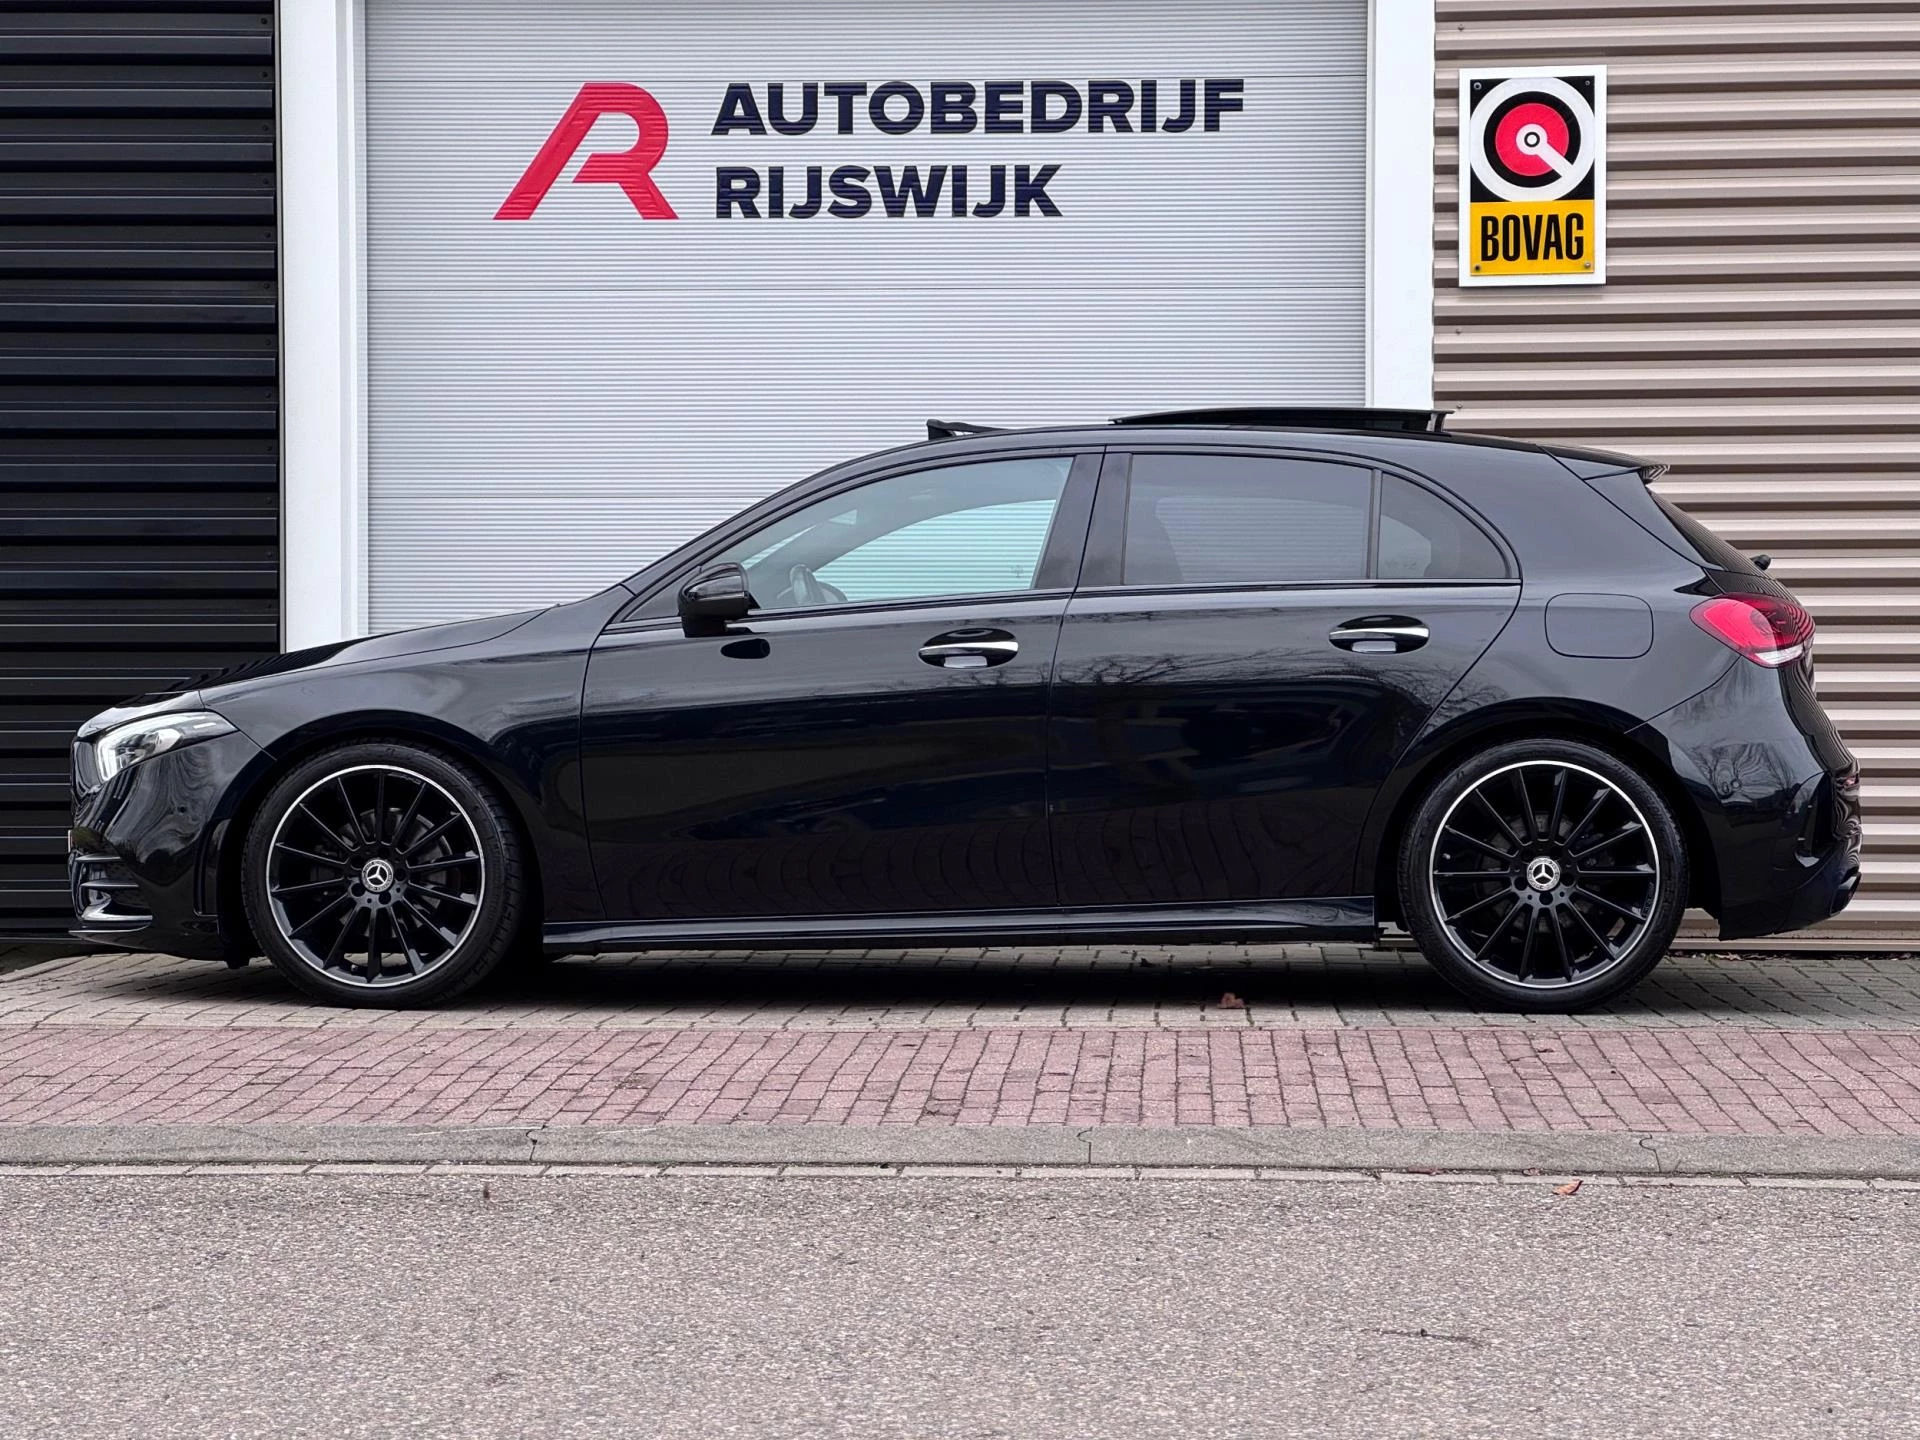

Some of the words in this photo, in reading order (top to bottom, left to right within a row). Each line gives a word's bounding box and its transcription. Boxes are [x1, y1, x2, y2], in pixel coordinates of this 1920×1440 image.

[711, 79, 1244, 135] AUTOBEDRIJF
[716, 165, 1063, 218] RIJSWIJK
[1481, 213, 1584, 261] BOVAG
